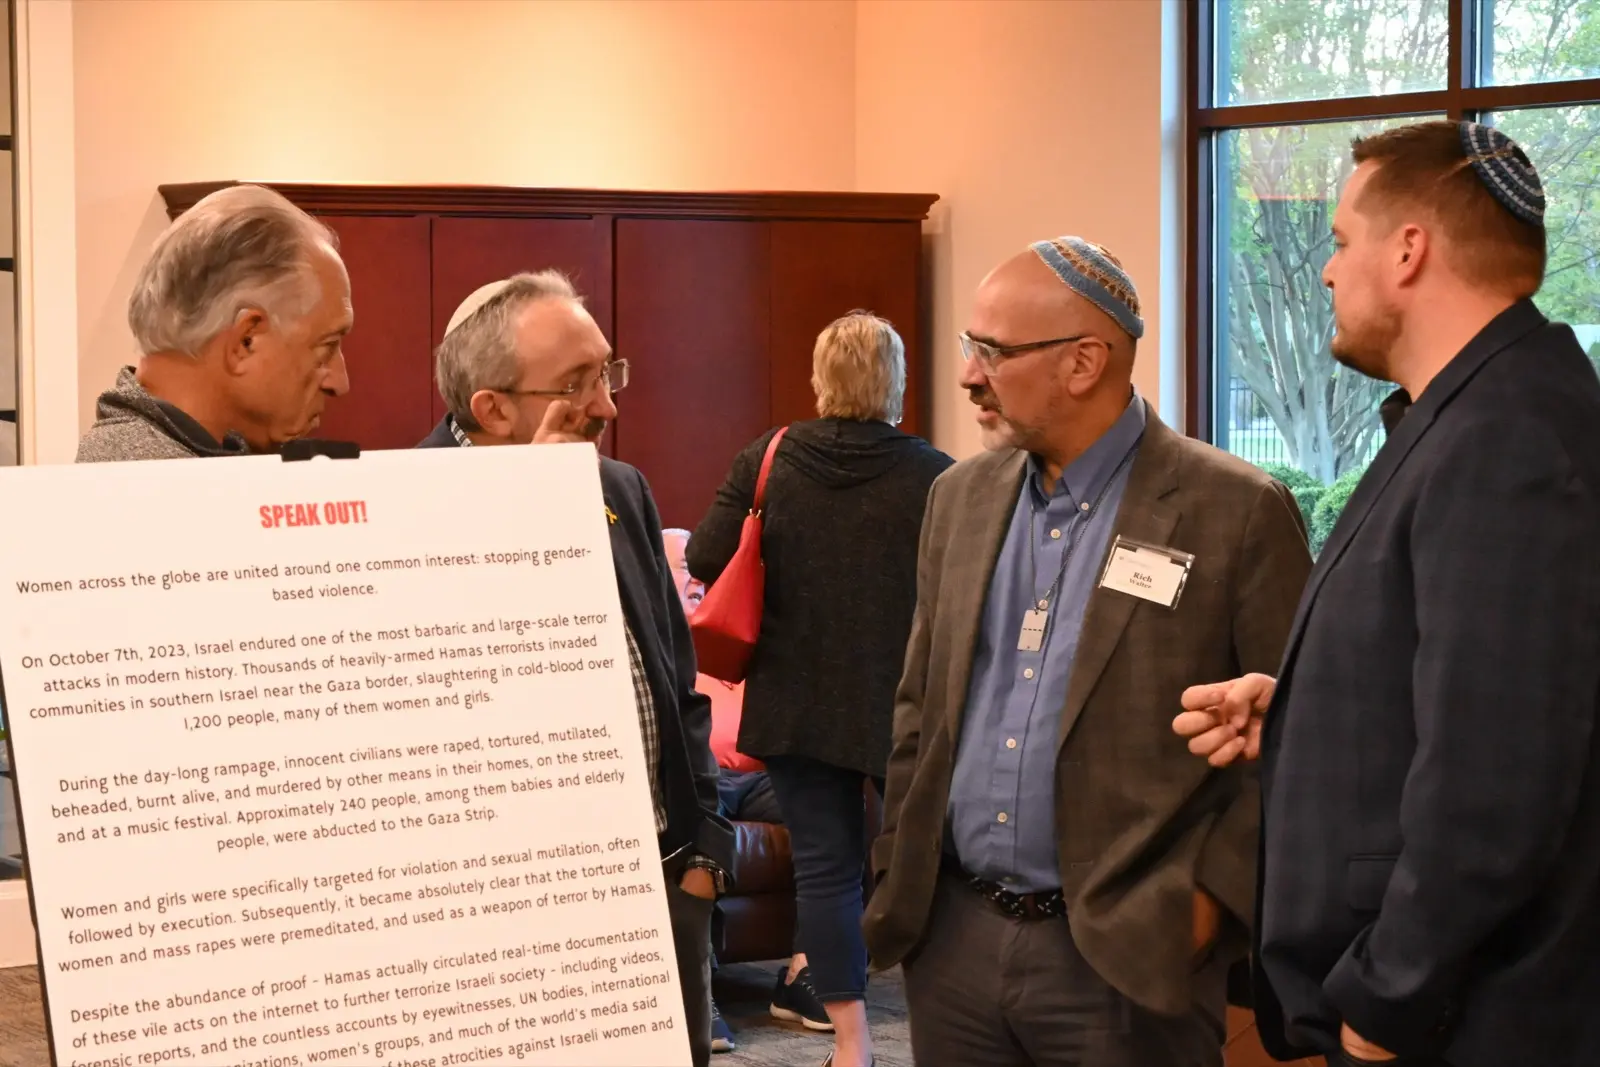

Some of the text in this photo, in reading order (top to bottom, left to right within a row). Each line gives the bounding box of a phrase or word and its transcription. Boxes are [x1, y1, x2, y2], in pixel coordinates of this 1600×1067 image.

[260, 500, 367, 529] SPEAK OUT!
[16, 546, 591, 594] Women across the globe are united around one common interest: stopping gender-
[272, 584, 378, 601] based violence.
[1133, 572, 1153, 583] Rich
[21, 614, 607, 669] On October 7th, 2023, Israel endured one of the most barbaric and large-scale terror
[44, 634, 597, 692] attacks in modern history. Thousands of heavily-armed Hamas terrorists invaded
[184, 690, 493, 731] 1,200 people, many of them women and girls.
[59, 725, 611, 794] During the day-long rampage, innocent civilians were raped, tortured, mutilated,
[57, 769, 625, 843] and at a music festival. Approximately 240 people, among them babies and elderly
[60, 837, 640, 920] Women and girls were specifically targeted for violation and sexual mutilation, often
[58, 883, 655, 972] women and mass rapes were premeditated, and used as a weapon of terror by Hamas.
[70, 927, 658, 1023] Despite the abundance of proof Hamas actually circulated real-time documentation
[72, 951, 663, 1048] of these vile acts on the internet to further terrorize Israeli society including videos,
[138, 1046, 195, 1065] reports,
[201, 1037, 228, 1055] and
[232, 1036, 257, 1049] the
[262, 1025, 330, 1045] countless
[336, 1014, 398, 1033] accounts
[402, 1010, 417, 1025] by
[423, 997, 515, 1022] eyewitnesses,
[519, 992, 537, 1005] UN
[542, 985, 587, 1001] bodies,
[592, 970, 670, 994] international
[307, 996, 657, 1063] women's groups, and much of the world's media said
[398, 1016, 674, 1067] these atrocities against Israeli women and
